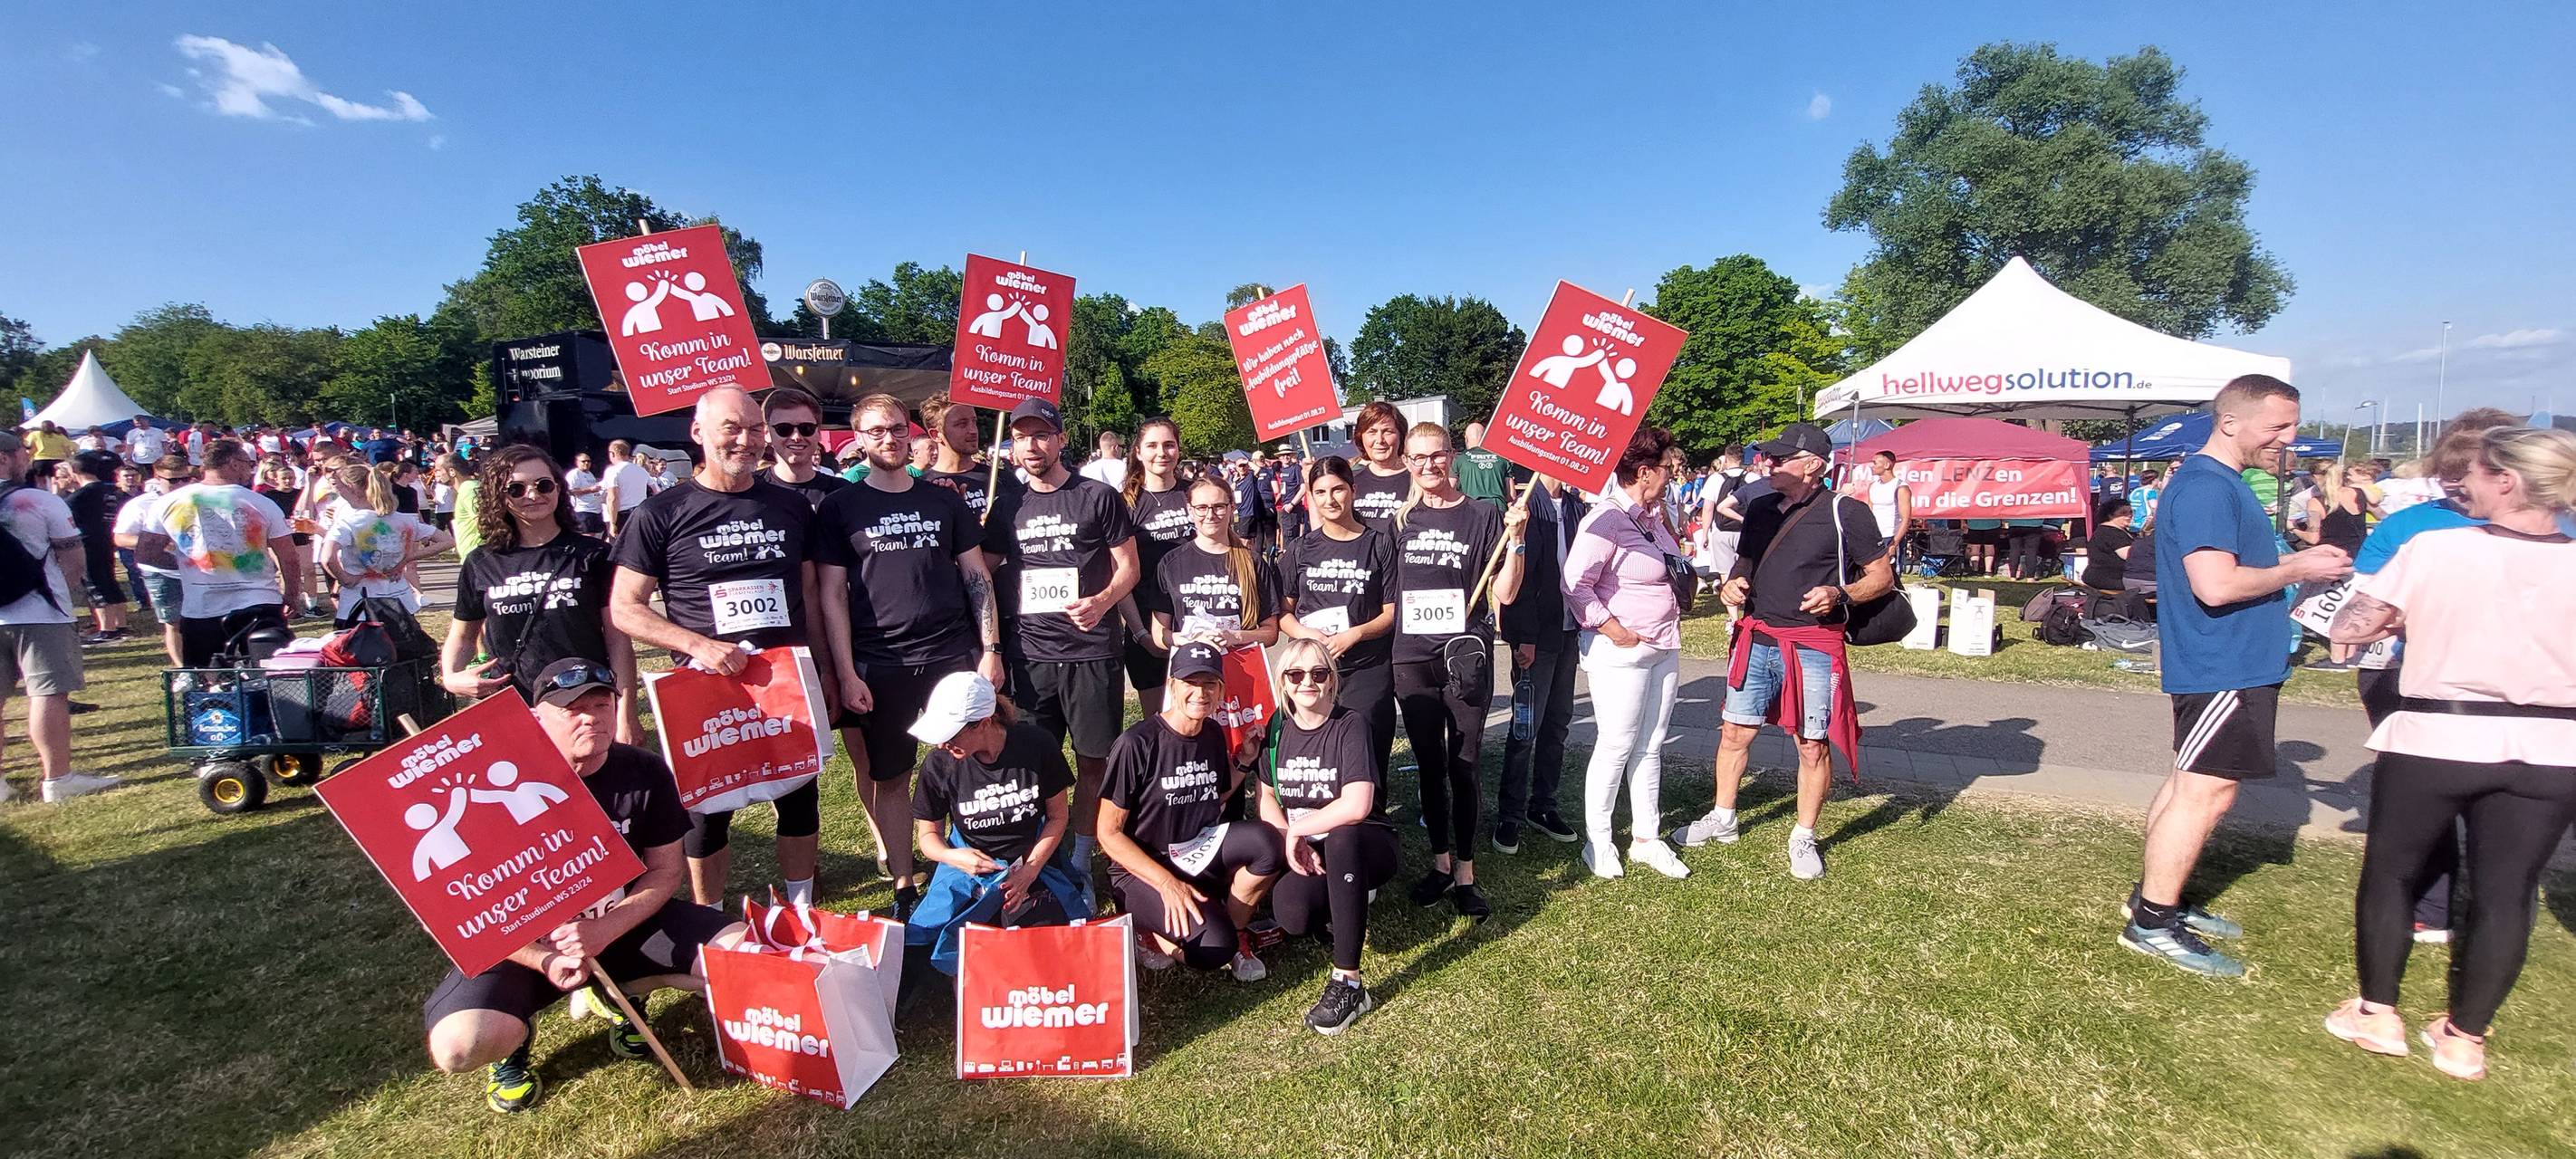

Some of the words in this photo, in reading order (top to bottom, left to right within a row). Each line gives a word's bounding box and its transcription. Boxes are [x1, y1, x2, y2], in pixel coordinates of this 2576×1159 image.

[622, 247, 688, 268] wiemer
[633, 241, 669, 257] möbel
[995, 275, 1047, 295] wiemer
[1007, 271, 1035, 283] möbel
[811, 292, 842, 303] Warsteiner
[1238, 304, 1297, 337] wiemer
[1247, 300, 1279, 321] möbel
[1599, 311, 1635, 330] möbel
[1582, 313, 1645, 348] wiemer
[509, 343, 561, 361] Warsteiner
[639, 337, 709, 362] Komm
[708, 331, 732, 350] in
[783, 342, 844, 362] Warsteiner
[1243, 358, 1259, 373] Wir
[1257, 343, 1284, 364] haben
[1283, 328, 1306, 349] noch
[639, 365, 693, 389] unser
[695, 348, 753, 376] Team!
[976, 344, 1028, 369] Komm
[1029, 355, 1046, 373] in
[1246, 340, 1319, 391] Ausbildungsplätze
[668, 386, 682, 396] Start
[681, 380, 708, 393] Studium
[706, 377, 718, 387] WS
[717, 374, 738, 385] 23/24
[964, 368, 1006, 385] unser
[1011, 371, 1053, 395] Team!
[1274, 367, 1302, 398] frei!
[1882, 368, 2153, 396] hellwegsolution.de
[971, 385, 1018, 400] Ausbildungsstart
[1529, 390, 1588, 432] Komm
[1588, 417, 1609, 440] in
[1504, 413, 1556, 443] unser
[1560, 430, 1611, 466] Team!
[1508, 435, 1560, 464] Ausbildungsstart
[1560, 456, 1591, 474] 01.08.23
[1365, 492, 1396, 501] möbel
[1935, 491, 1972, 508] die
[1975, 487, 2078, 507] Grenzen!
[879, 512, 921, 526] möbel
[1026, 514, 1062, 528] möbel
[1155, 508, 1187, 521] möbel
[716, 518, 764, 535] möbel
[864, 520, 942, 539] wiemer
[1016, 522, 1078, 541] wiemer
[1150, 529, 1179, 541] Team!
[1418, 529, 1455, 541] möbel
[698, 529, 786, 549] wiemer
[870, 536, 908, 553] Team!
[1020, 540, 1048, 555] Team!
[1406, 540, 1470, 555] wiemer
[704, 547, 749, 564] Team!
[1321, 558, 1358, 569] möbel
[1404, 552, 1435, 565] Team!
[1193, 574, 1229, 584] möbel
[1306, 566, 1371, 581] wiemer
[1031, 585, 1070, 599] 3006
[1179, 582, 1242, 597] wieme
[1307, 579, 1338, 593] Team!
[726, 598, 779, 618] 3002
[1182, 596, 1213, 609] Team!
[1412, 607, 1456, 621] 3005
[703, 703, 763, 733] möbel
[683, 714, 793, 758] wiemer
[388, 733, 484, 790] wiemer
[399, 734, 454, 770] möbel
[1286, 755, 1321, 769] möbel
[1176, 760, 1208, 776] möbel
[1276, 767, 1338, 782] wiemer
[974, 779, 1019, 800] möbel
[1165, 789, 1197, 807] Team!
[1277, 783, 1304, 798] Team!
[958, 784, 1040, 816] wiemer
[964, 811, 1005, 831] Team!
[447, 847, 545, 902] Komm
[541, 827, 576, 854] in
[457, 886, 529, 939] unser
[530, 835, 610, 893] Team!
[500, 917, 522, 936] Start
[520, 900, 556, 927] Studium
[553, 889, 571, 905] WS
[568, 876, 593, 894] 23/24
[1008, 984, 1075, 1006] möbel
[745, 1006, 802, 1032] möbel
[981, 1002, 1110, 1029] wiemer
[724, 1020, 830, 1058] wiemer
